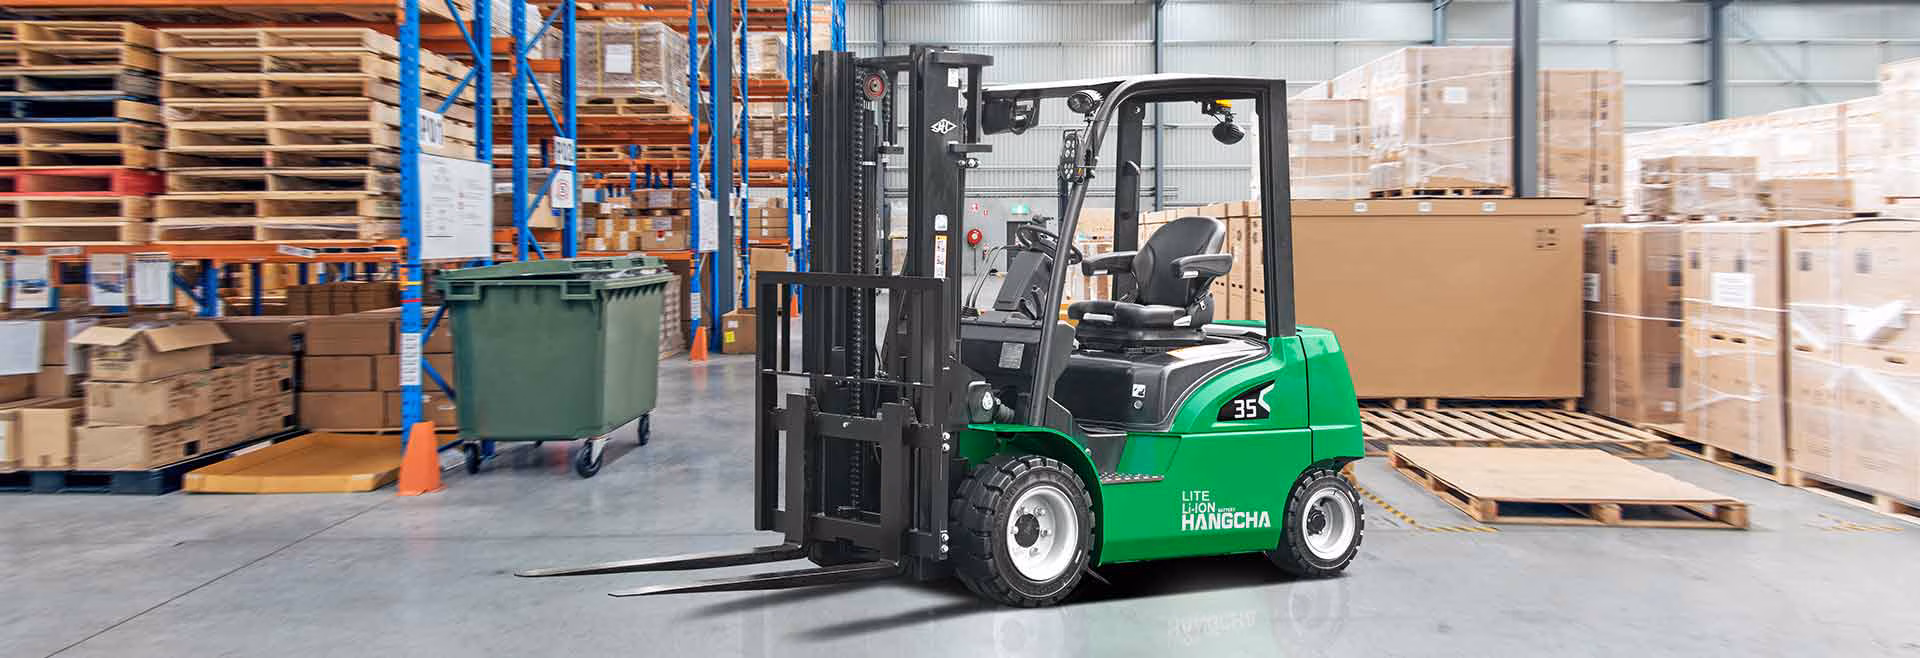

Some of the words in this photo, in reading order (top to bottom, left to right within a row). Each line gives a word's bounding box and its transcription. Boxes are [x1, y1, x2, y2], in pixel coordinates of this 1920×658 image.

[1233, 399, 1257, 419] 35
[1182, 490, 1210, 502] LITE
[1182, 502, 1216, 513] Li-ION
[1181, 511, 1271, 531] HANGCHA
